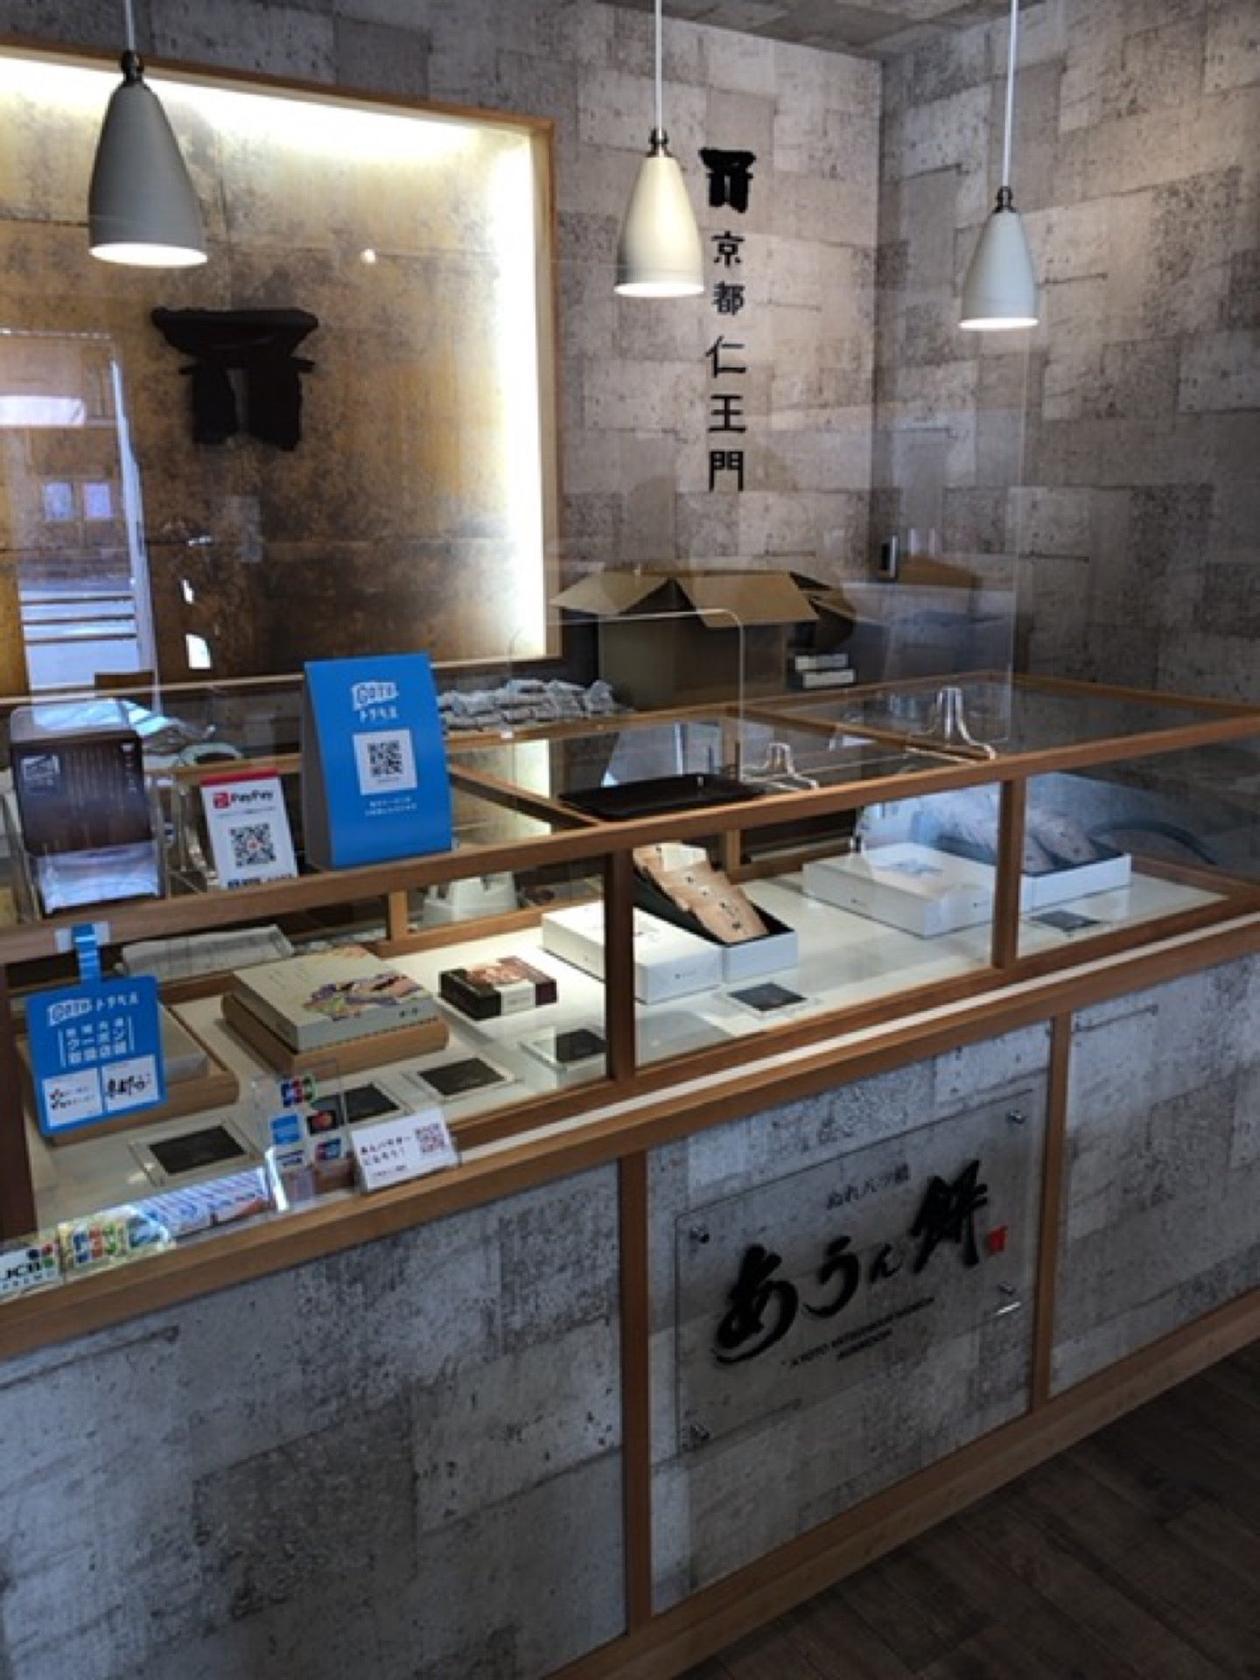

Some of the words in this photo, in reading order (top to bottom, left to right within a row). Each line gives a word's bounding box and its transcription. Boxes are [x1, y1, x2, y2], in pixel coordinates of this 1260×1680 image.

[704, 230, 747, 493] 京都仁王門
[229, 789, 274, 803] PayPay
[712, 1159, 988, 1365] あうん餅
